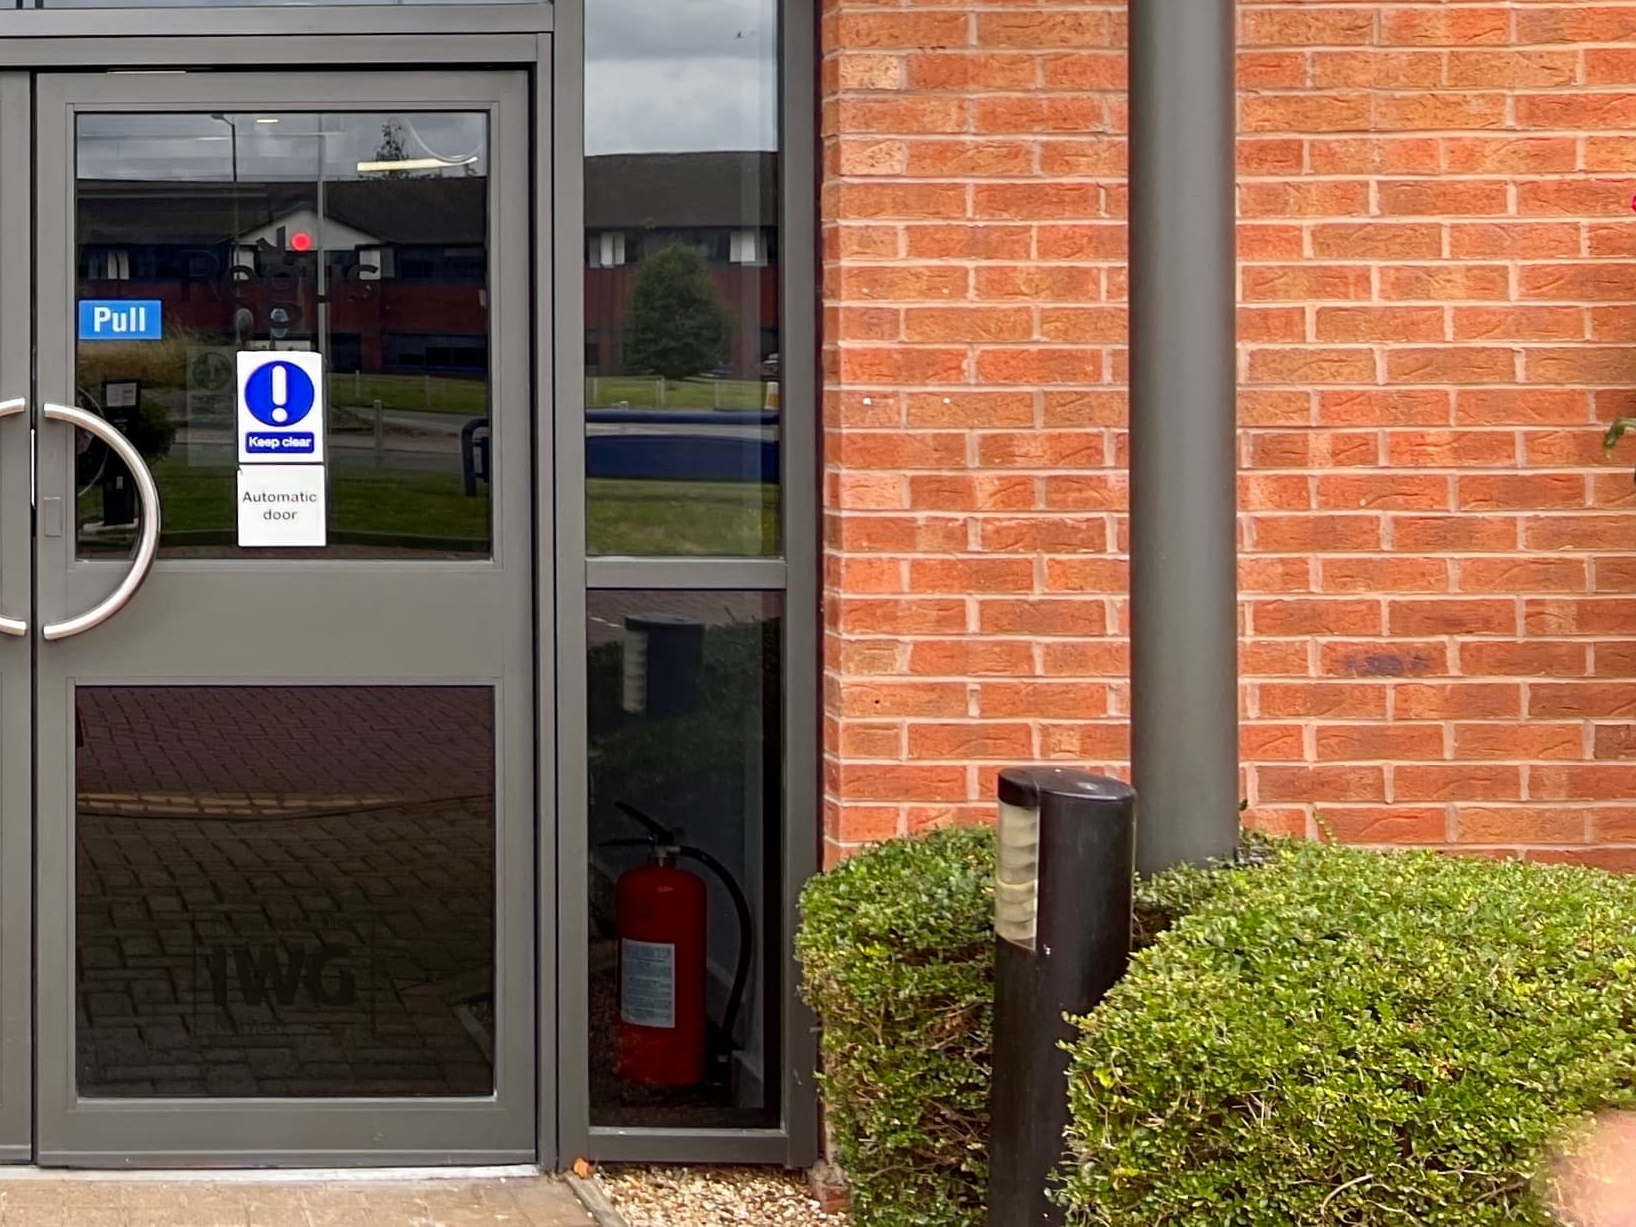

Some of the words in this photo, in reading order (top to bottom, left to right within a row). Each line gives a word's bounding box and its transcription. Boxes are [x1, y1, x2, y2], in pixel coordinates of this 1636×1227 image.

[94, 306, 146, 333] Pull
[248, 436, 280, 449] Keep
[282, 436, 312, 447] clear
[242, 490, 318, 503] Automatic
[262, 509, 298, 521] door
